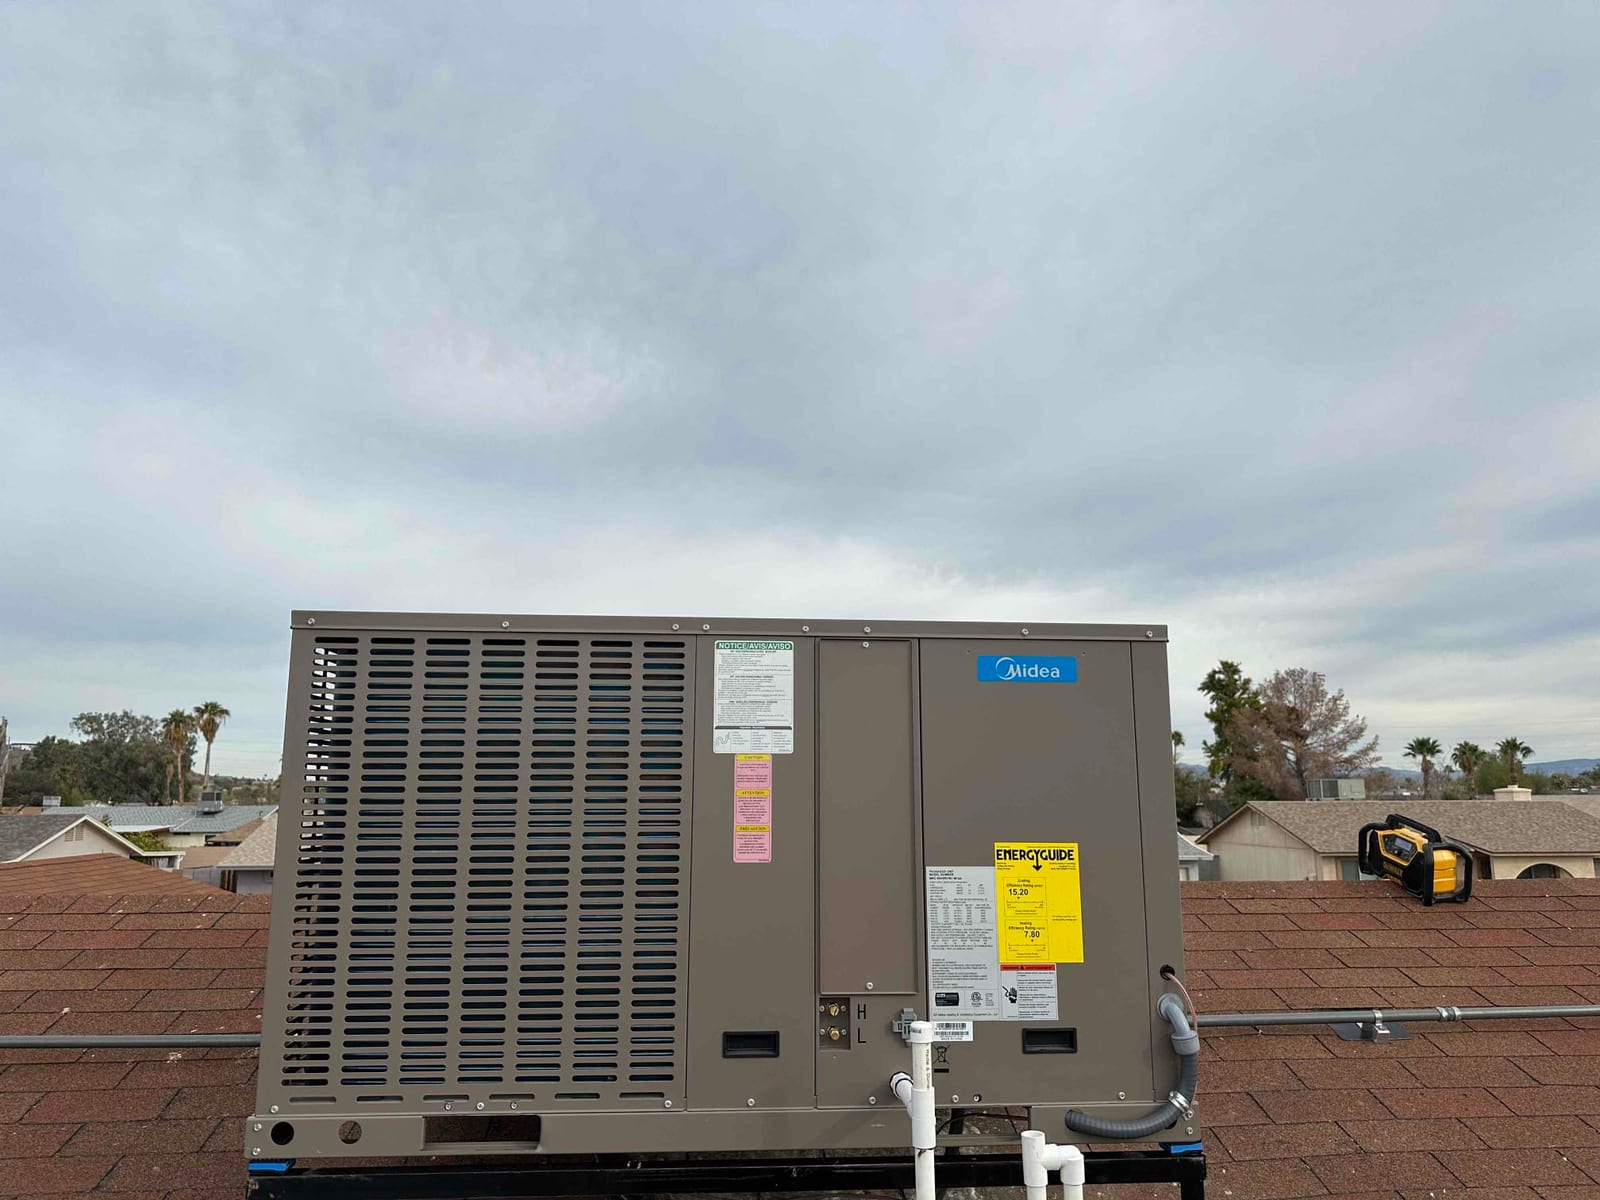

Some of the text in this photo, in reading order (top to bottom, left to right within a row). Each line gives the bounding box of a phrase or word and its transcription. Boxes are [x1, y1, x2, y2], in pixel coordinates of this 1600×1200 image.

[718, 642, 791, 650] NOTICE/AVIS/AVISO
[1001, 661, 1060, 679] Midea
[996, 849, 1075, 861] ENERGYGUIDE
[1024, 930, 1040, 938] 7.80
[858, 1004, 866, 1019] H
[858, 1028, 867, 1043] L
